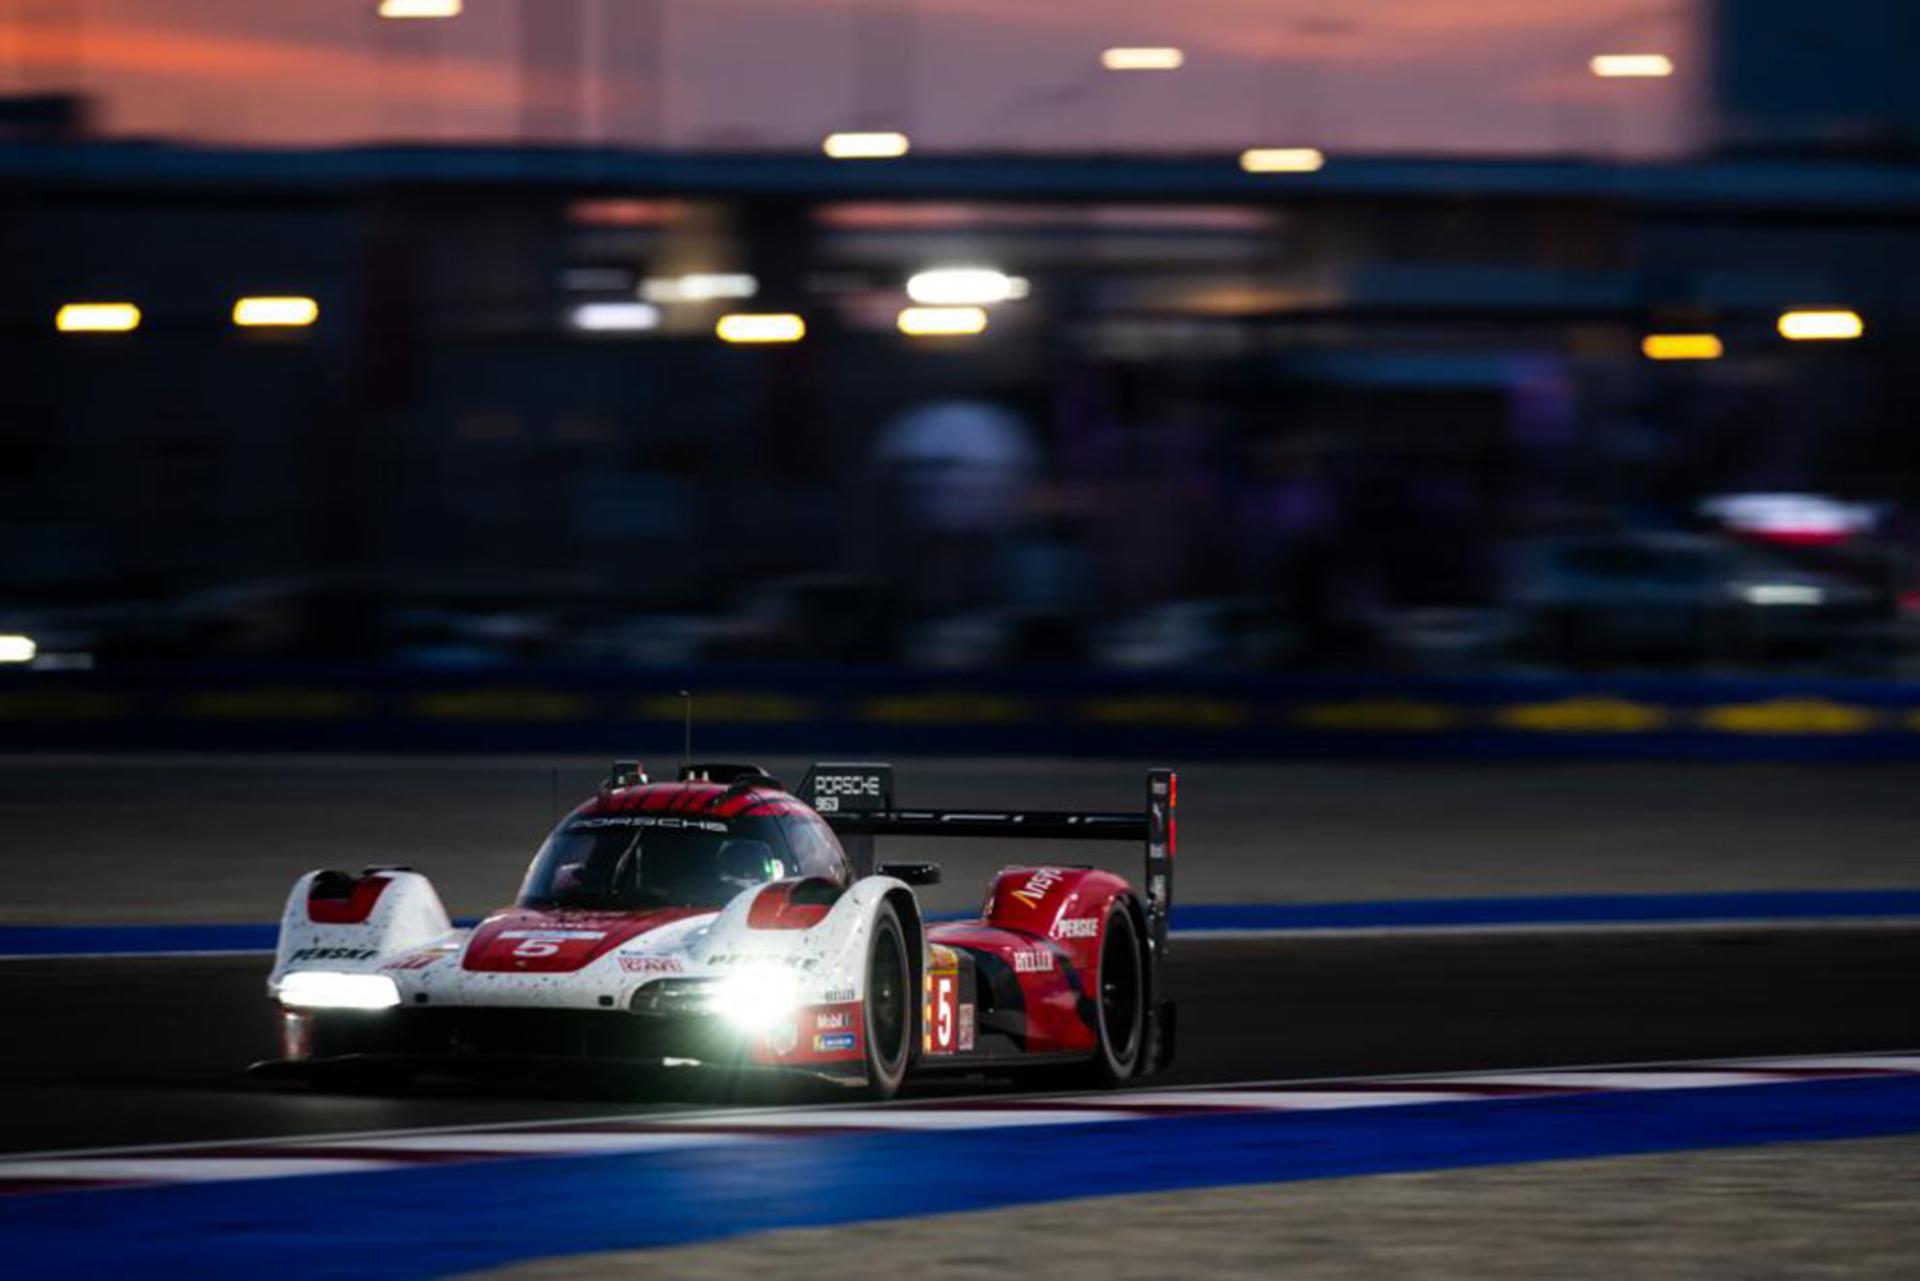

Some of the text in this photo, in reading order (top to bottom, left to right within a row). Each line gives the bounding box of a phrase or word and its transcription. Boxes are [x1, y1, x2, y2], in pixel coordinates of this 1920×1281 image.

[814, 775, 880, 796] PORSCHE
[571, 816, 729, 832] PORSCHE
[1010, 869, 1063, 910] Ansy
[1058, 918, 1099, 939] PENSKE
[512, 938, 565, 957] 5
[938, 979, 951, 1047] 5
